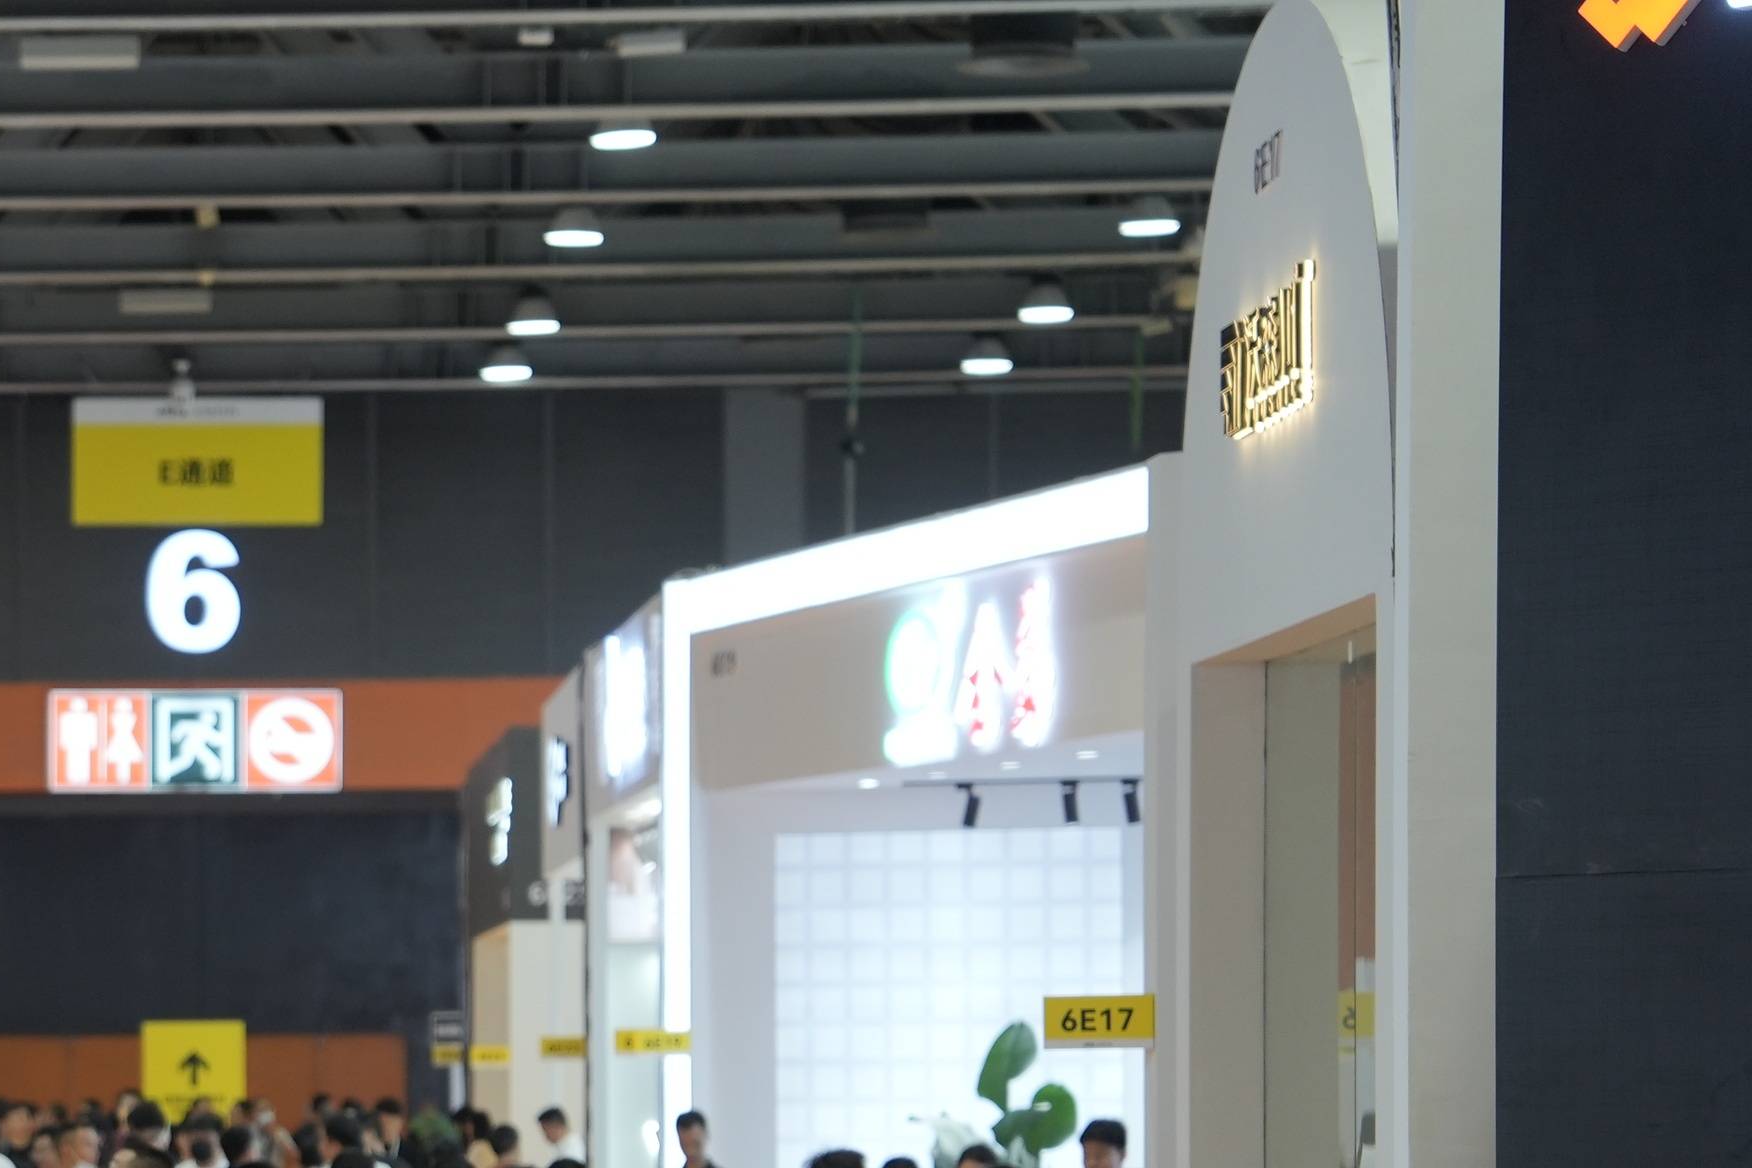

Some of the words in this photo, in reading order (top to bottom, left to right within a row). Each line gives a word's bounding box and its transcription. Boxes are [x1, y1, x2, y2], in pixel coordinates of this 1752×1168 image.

[159, 457, 234, 486] E通道
[145, 528, 241, 653] 6
[1061, 1007, 1134, 1031] 6E17
